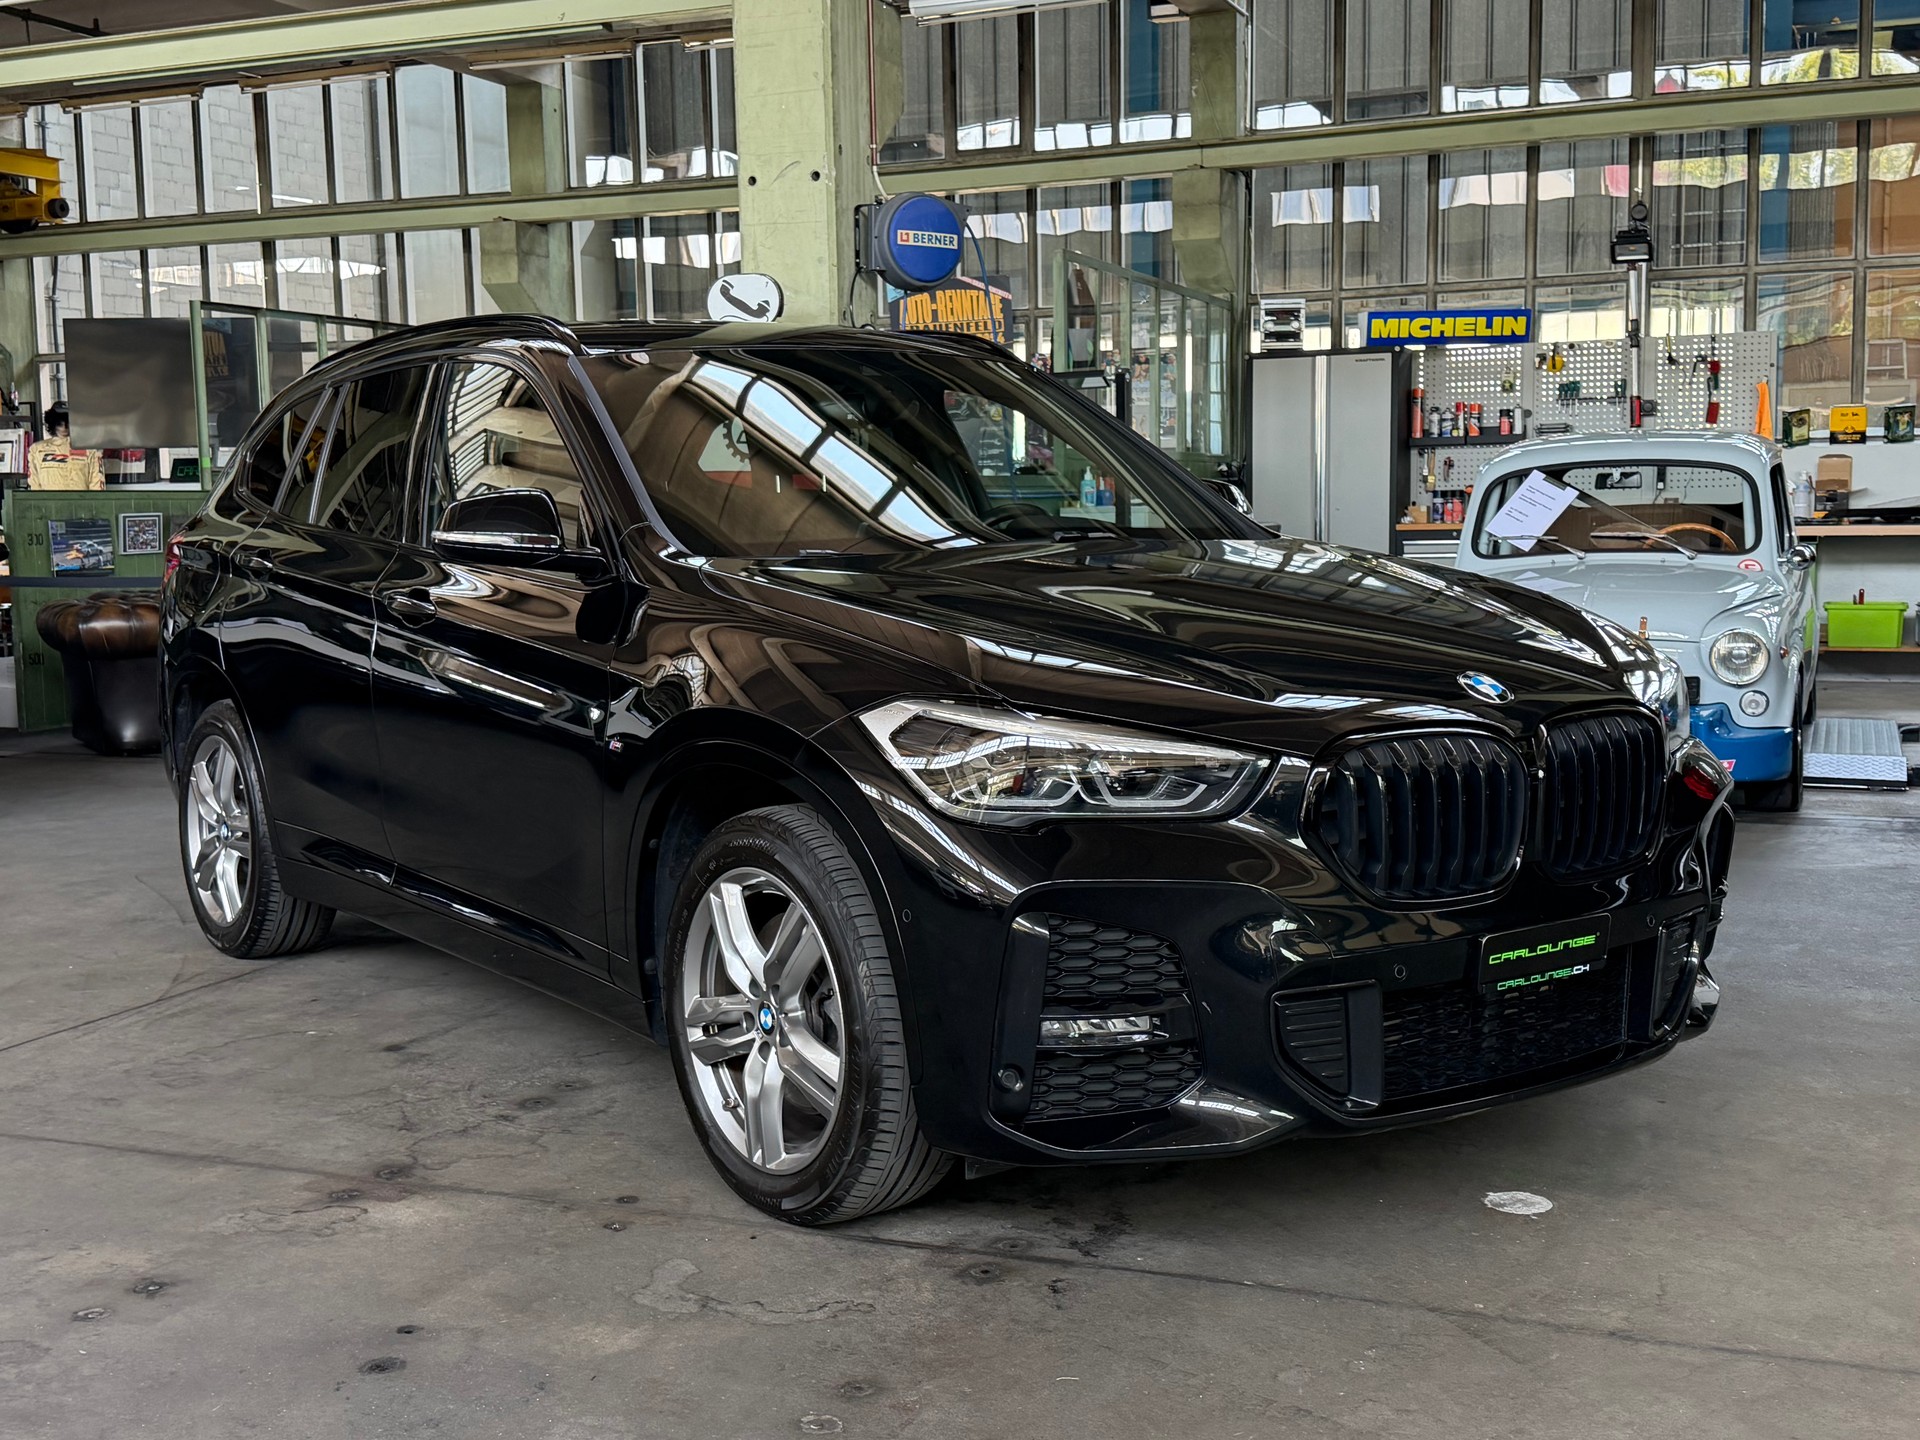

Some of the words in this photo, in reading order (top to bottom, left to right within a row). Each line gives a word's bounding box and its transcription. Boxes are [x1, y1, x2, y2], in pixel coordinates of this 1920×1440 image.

[913, 233, 955, 246] BERNER
[1371, 316, 1527, 338] MICHELIN
[1489, 935, 1596, 965] CARLOUNGE
[1497, 964, 1590, 991] CARLOUNGE.CH
